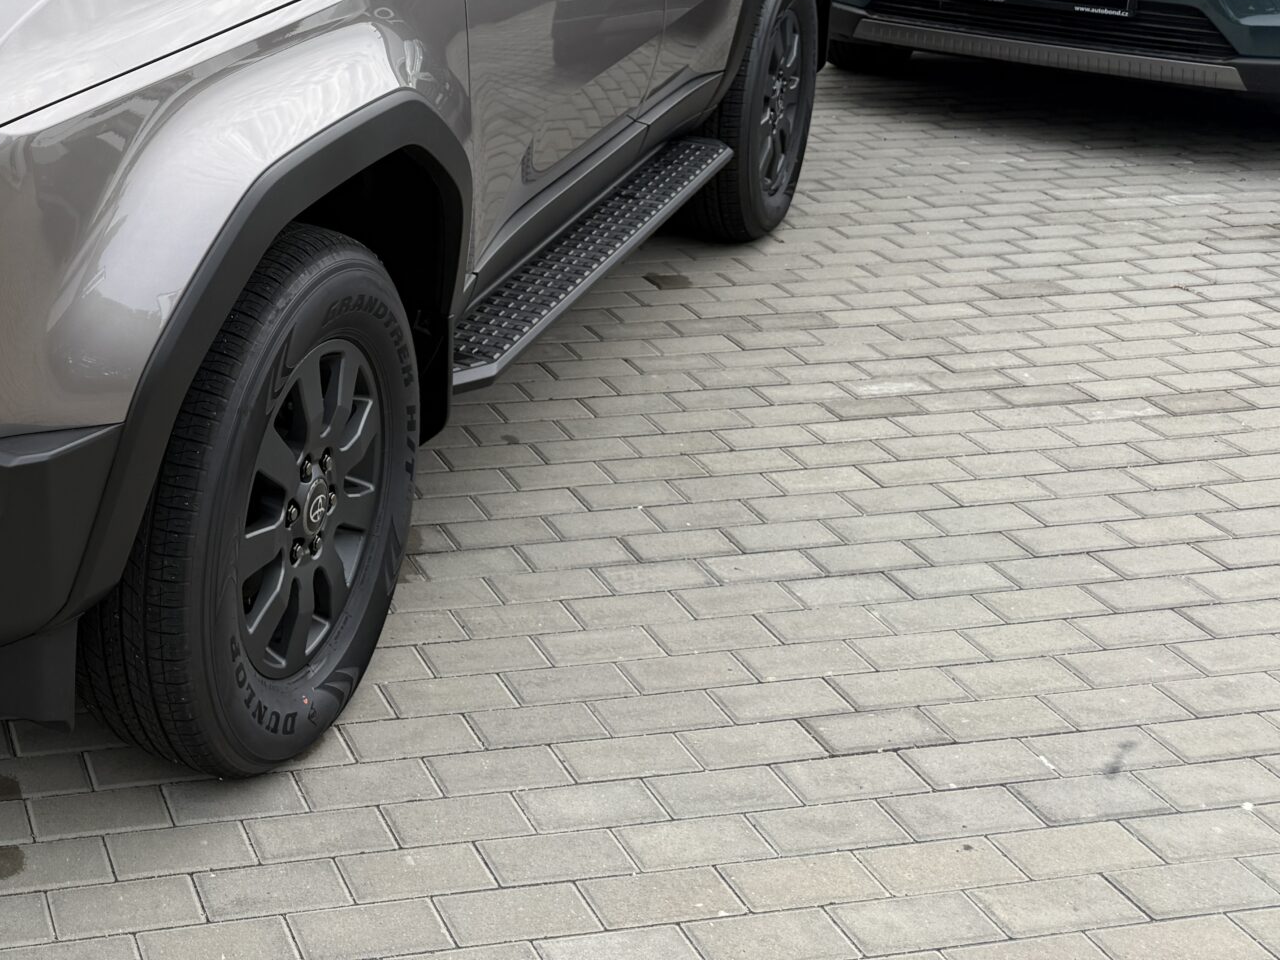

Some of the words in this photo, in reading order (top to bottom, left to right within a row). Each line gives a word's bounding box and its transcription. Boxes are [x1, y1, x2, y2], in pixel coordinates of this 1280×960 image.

[1073, 5, 1129, 17] www.autobond.cz
[323, 294, 414, 388] GRANDTREK
[229, 635, 298, 735] DUNLOP
